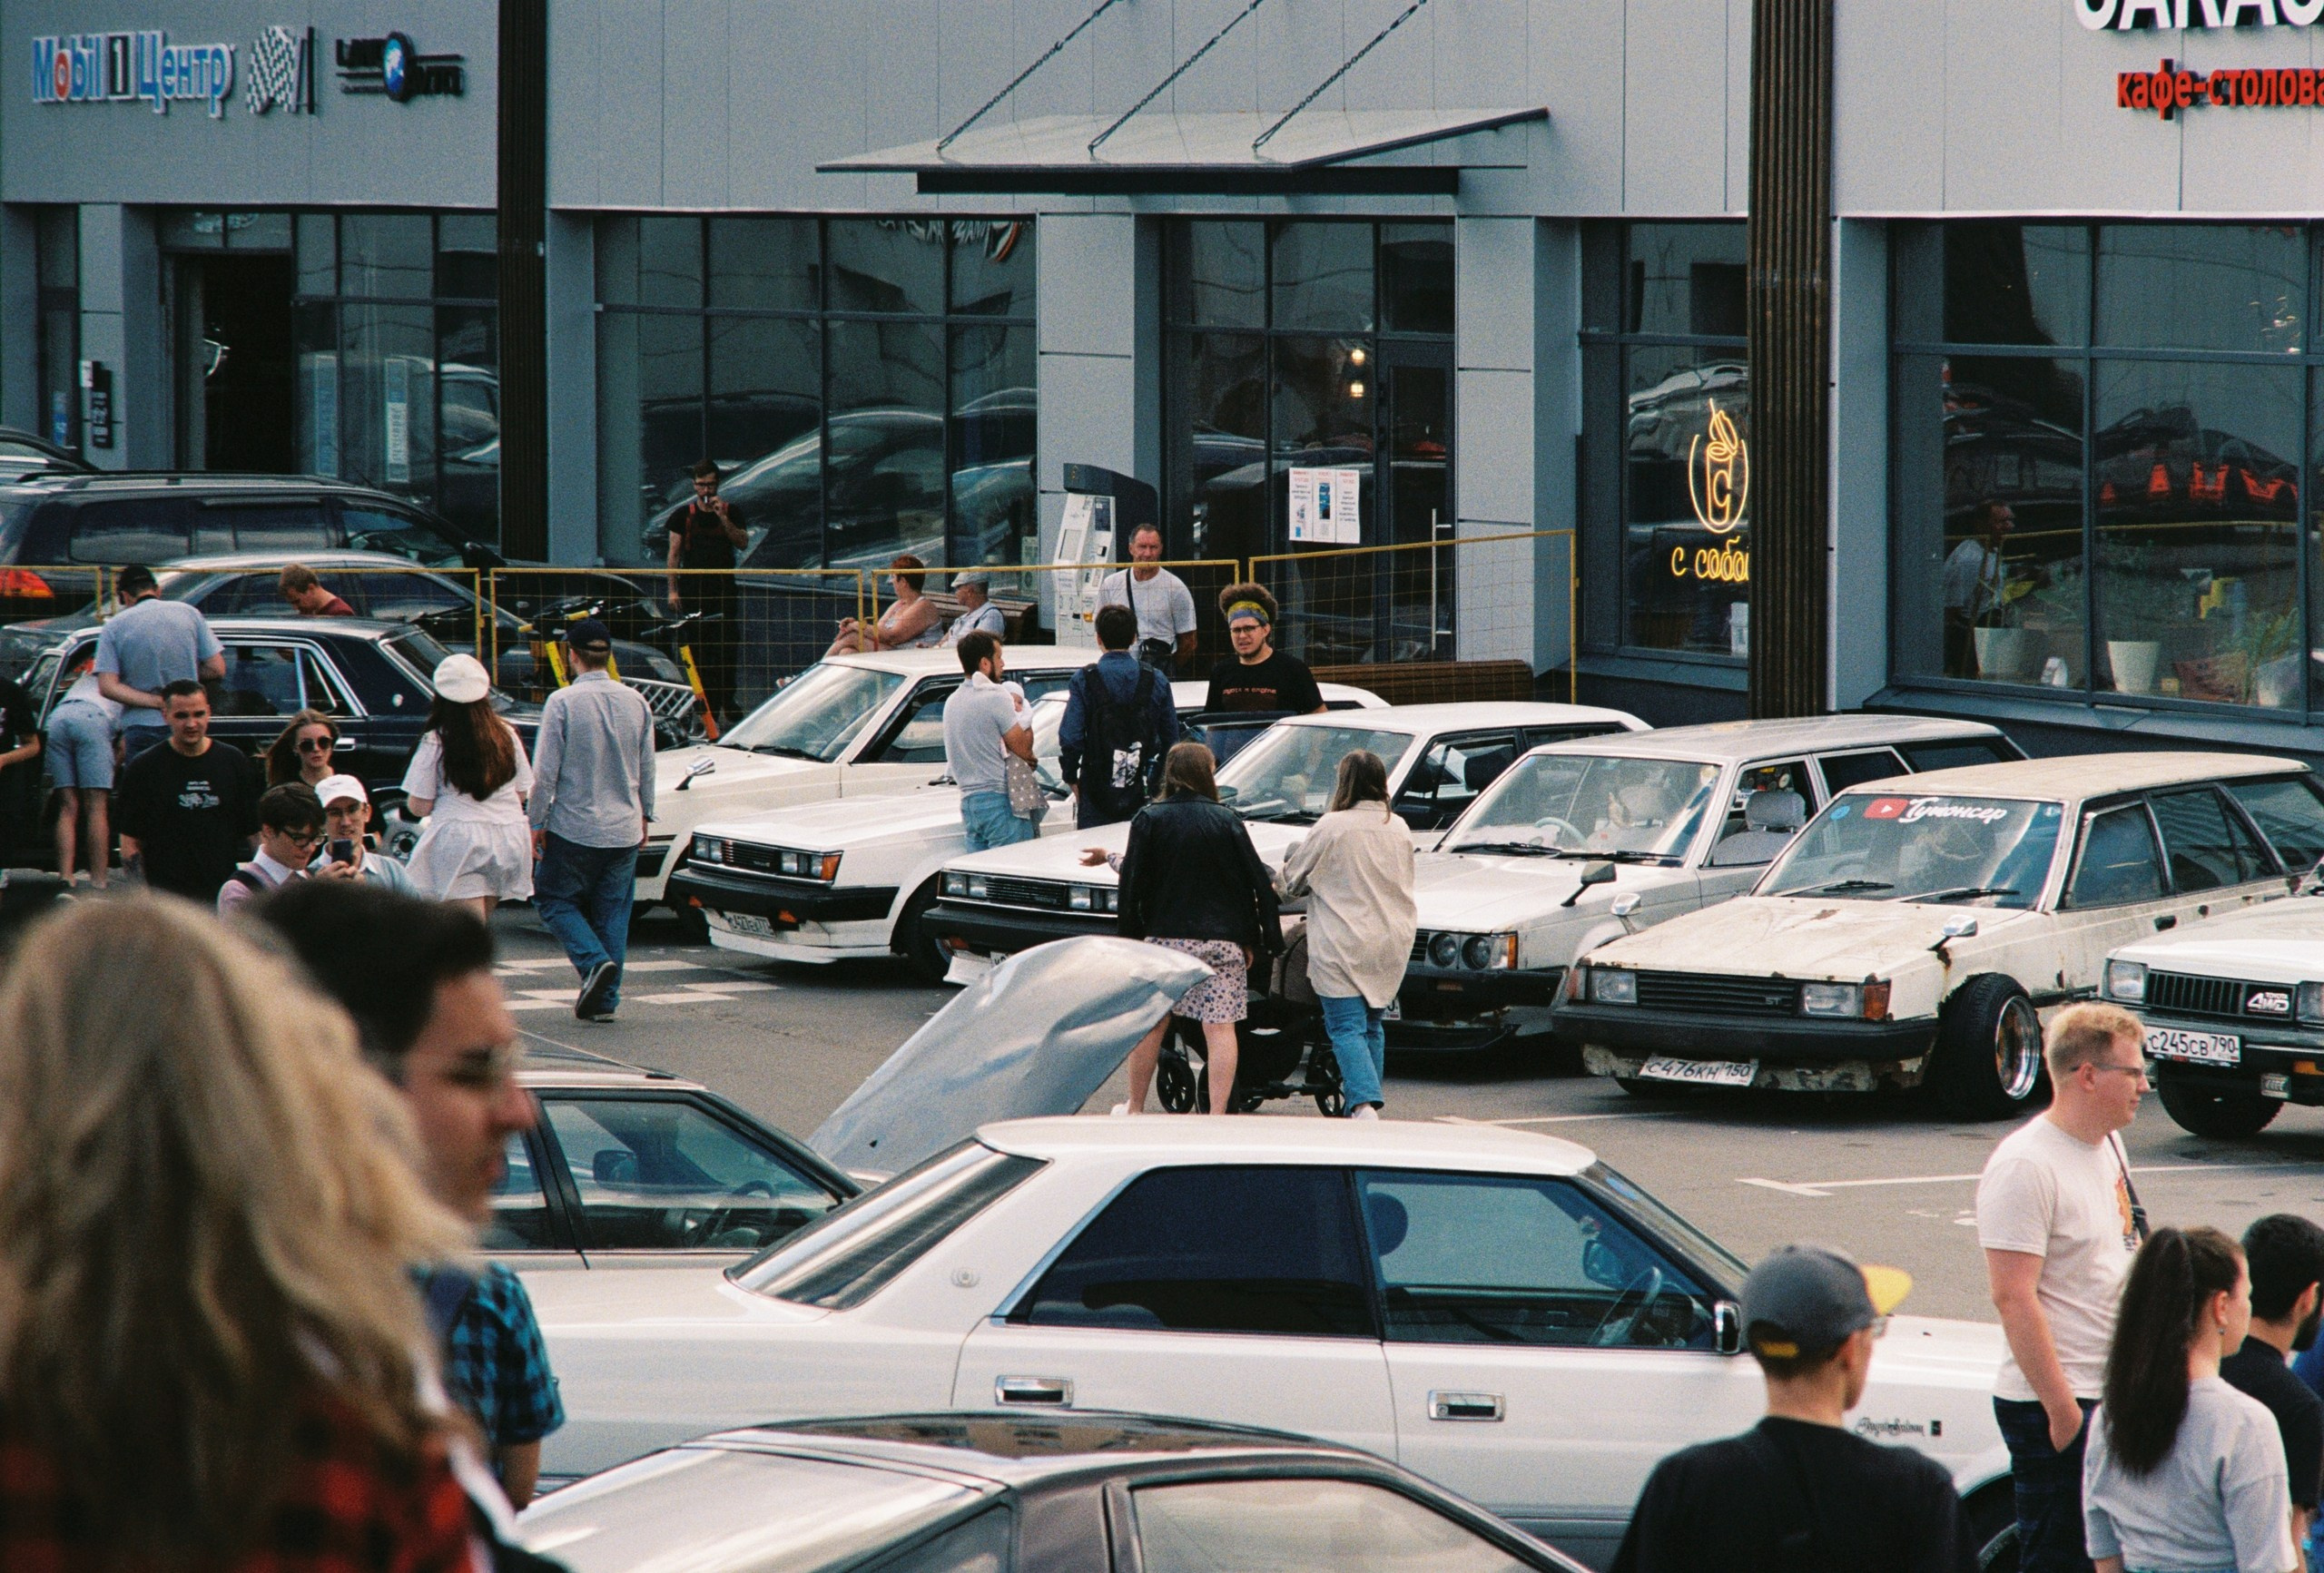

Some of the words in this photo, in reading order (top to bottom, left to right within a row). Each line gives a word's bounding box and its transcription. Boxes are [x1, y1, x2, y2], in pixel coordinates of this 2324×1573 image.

[33, 34, 107, 103] Mobil
[108, 33, 135, 101] 1
[137, 31, 234, 118] Центр
